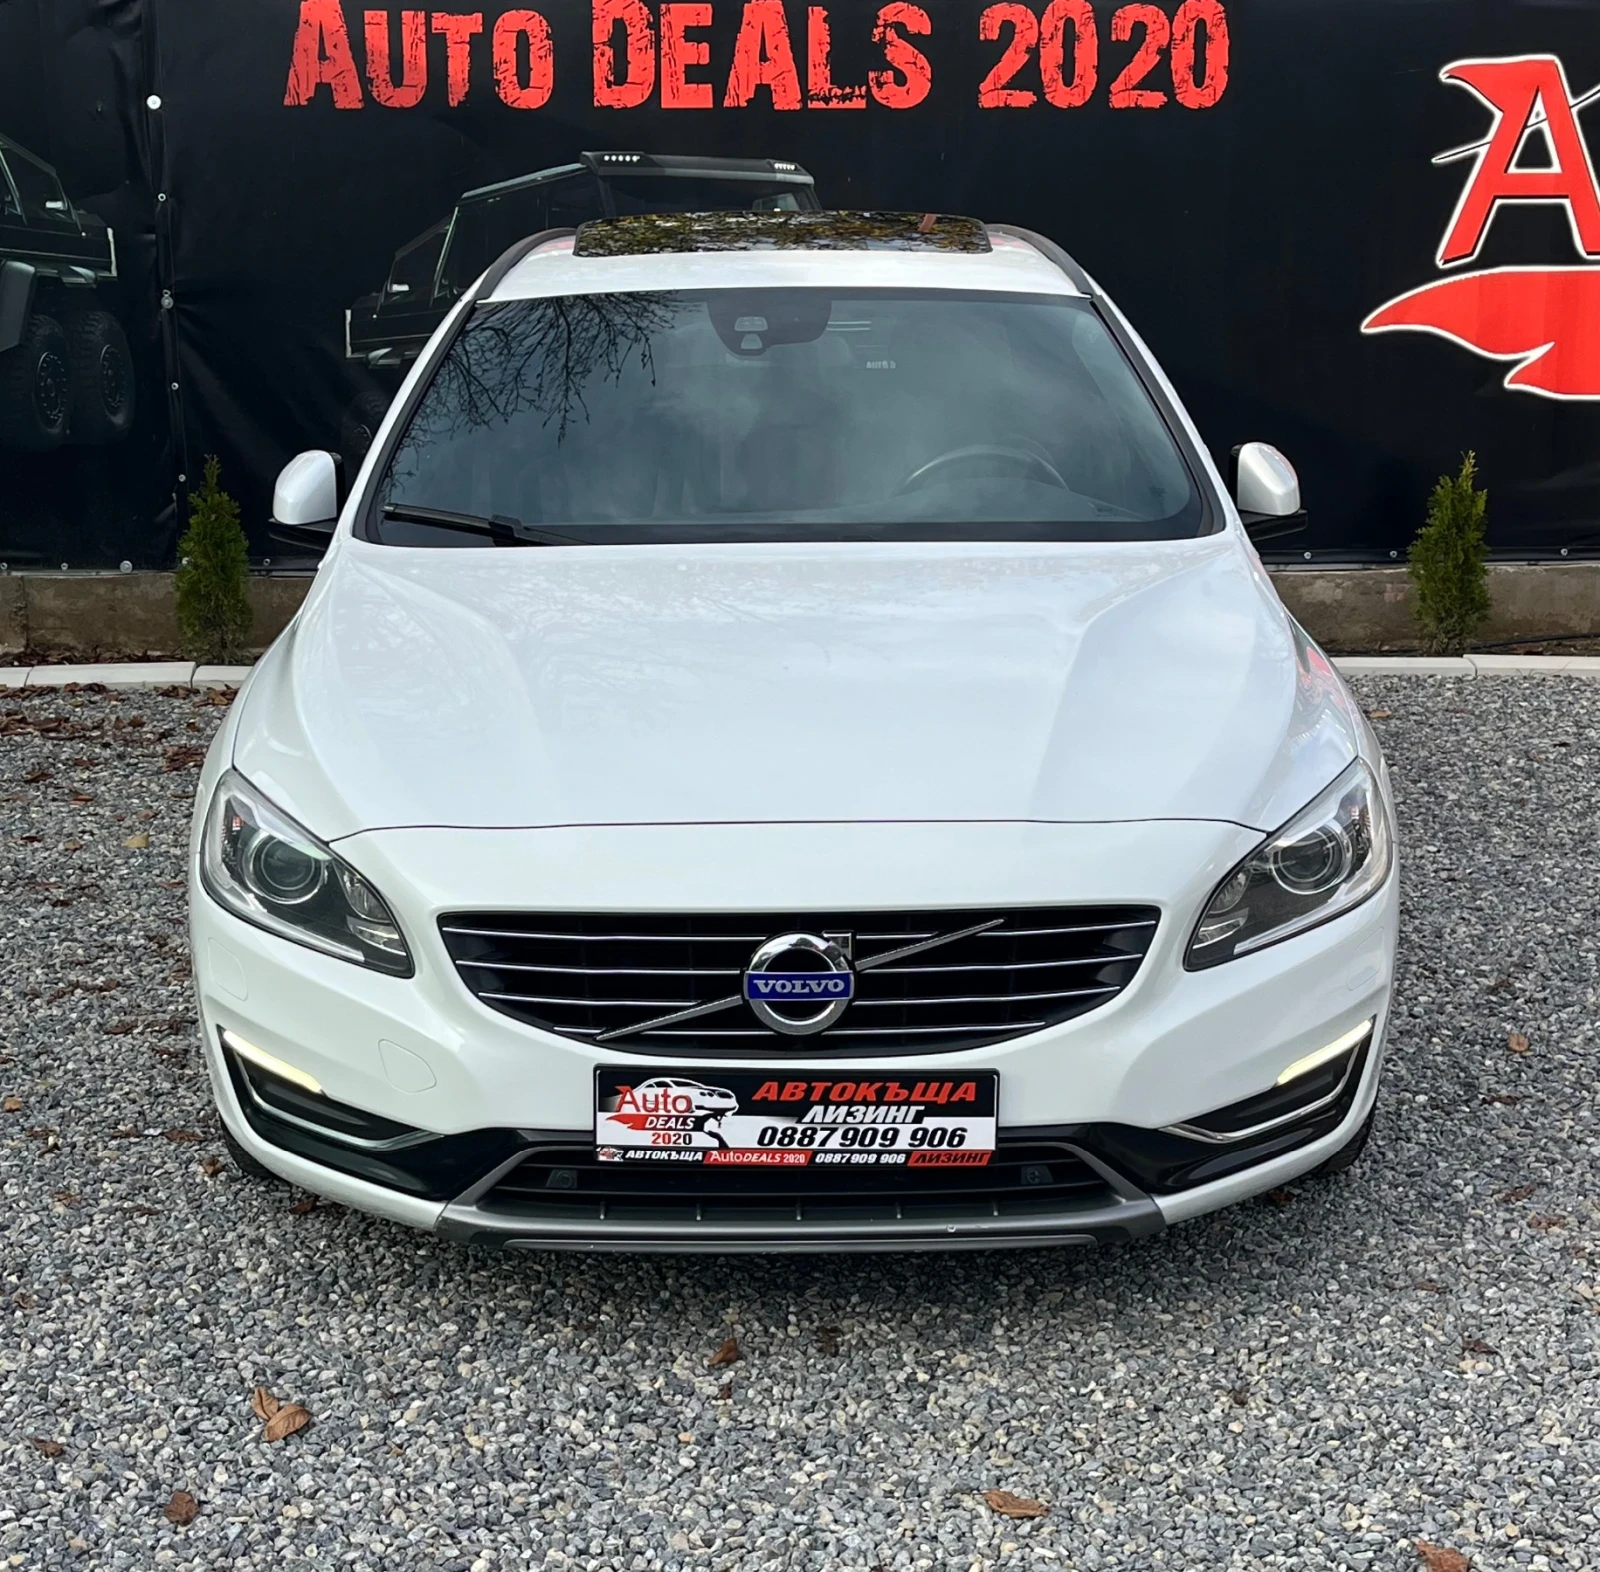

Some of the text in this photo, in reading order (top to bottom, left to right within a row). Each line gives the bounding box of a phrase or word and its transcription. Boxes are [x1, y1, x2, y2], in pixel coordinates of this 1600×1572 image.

[284, 0, 1230, 110] AUTO DEALS 2020
[753, 979, 845, 993] VOLVO
[614, 1085, 693, 1113] Auto
[751, 1081, 977, 1104] АВТОКЪЩА
[801, 1105, 926, 1123] ЛИЗИНГ
[644, 1116, 695, 1130] DEALS
[651, 1132, 693, 1146] 2020
[907, 1127, 968, 1148] 906
[625, 1150, 703, 1161] АВТОКЪЩА
[783, 1153, 805, 1164] 2020
[879, 1153, 906, 1164] 906
[914, 1152, 989, 1164] ЛИЗИНГ
